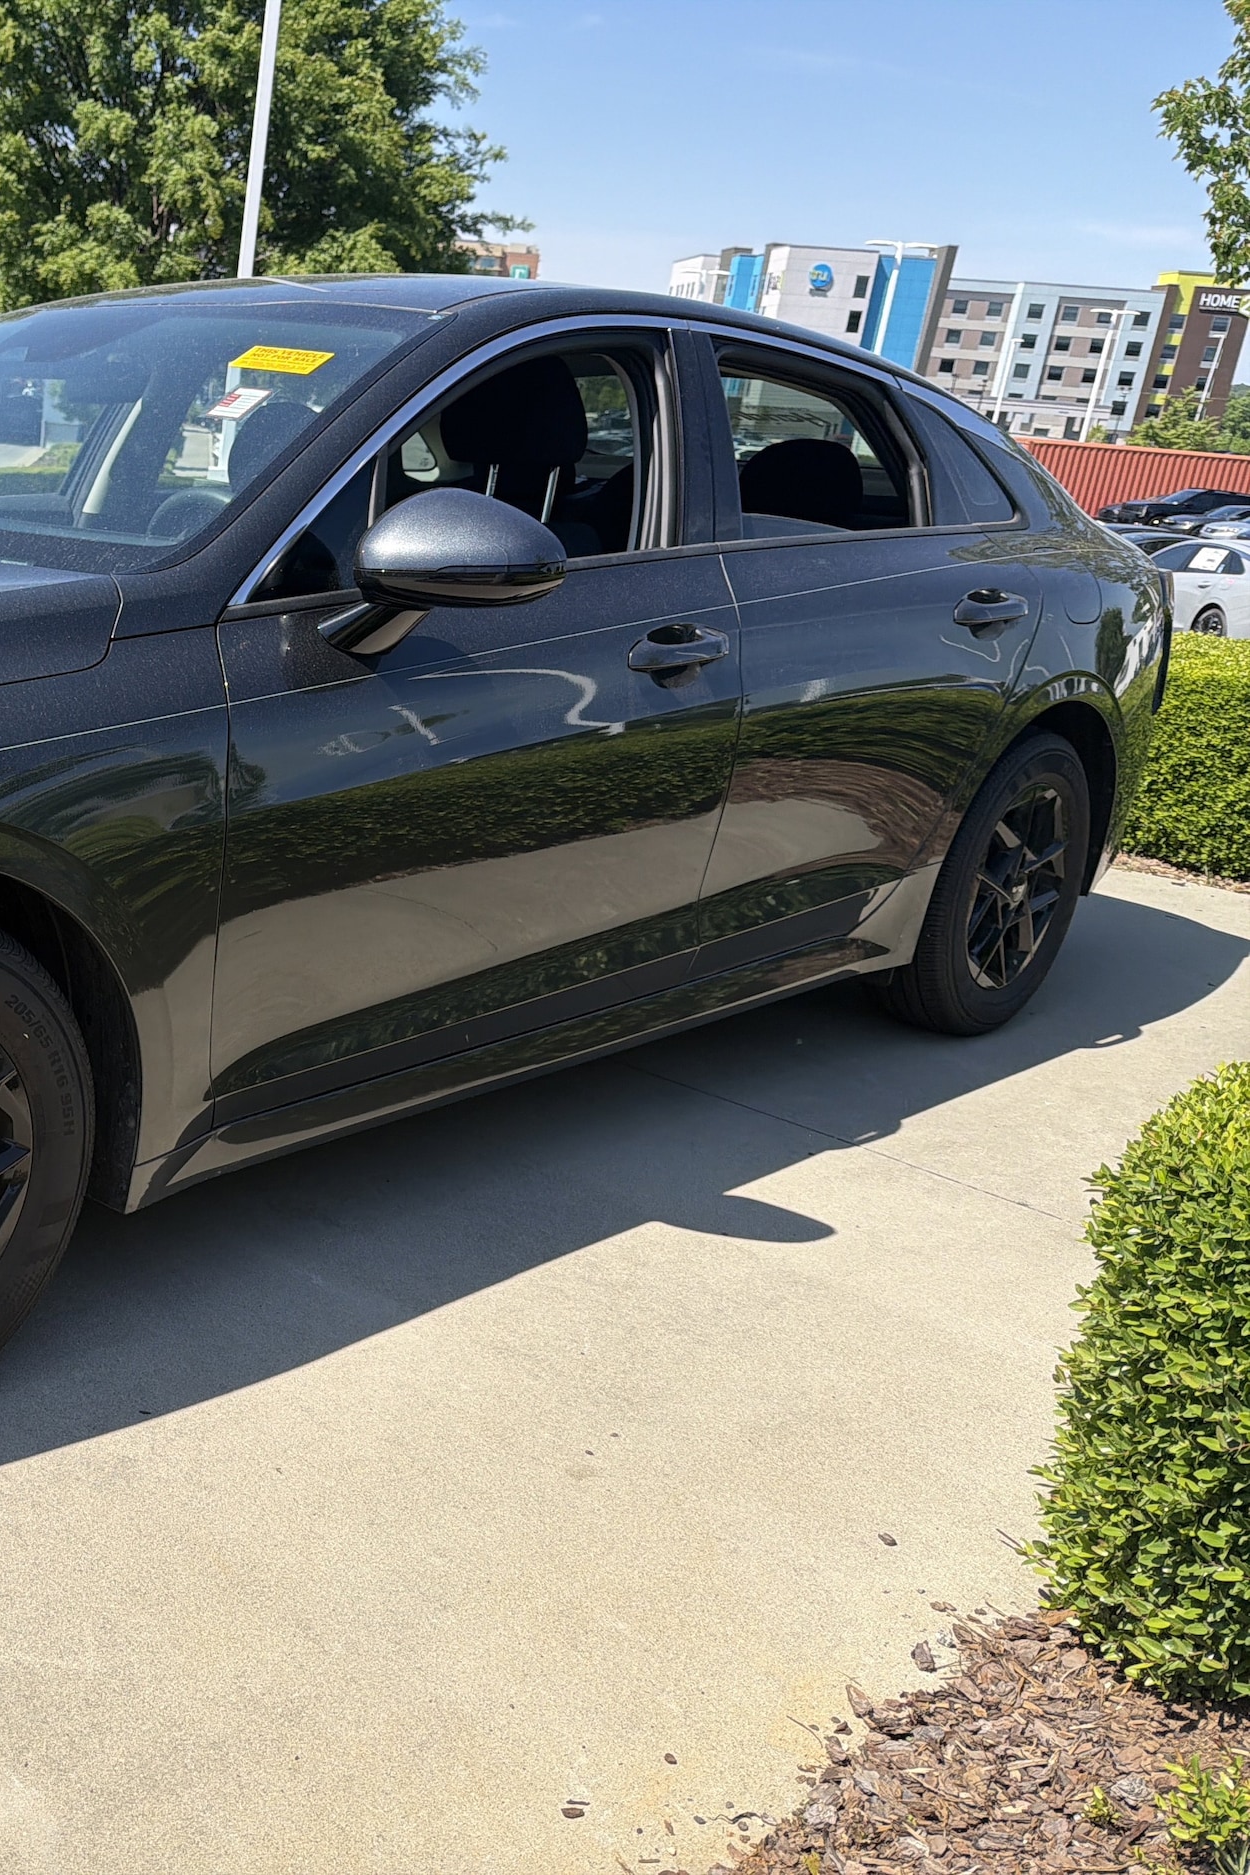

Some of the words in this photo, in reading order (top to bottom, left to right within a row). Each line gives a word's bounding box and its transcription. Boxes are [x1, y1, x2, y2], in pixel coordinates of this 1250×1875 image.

[3, 993, 54, 1049] 205/65
[48, 1050, 69, 1089] R16
[60, 1092, 75, 1136] 95H
